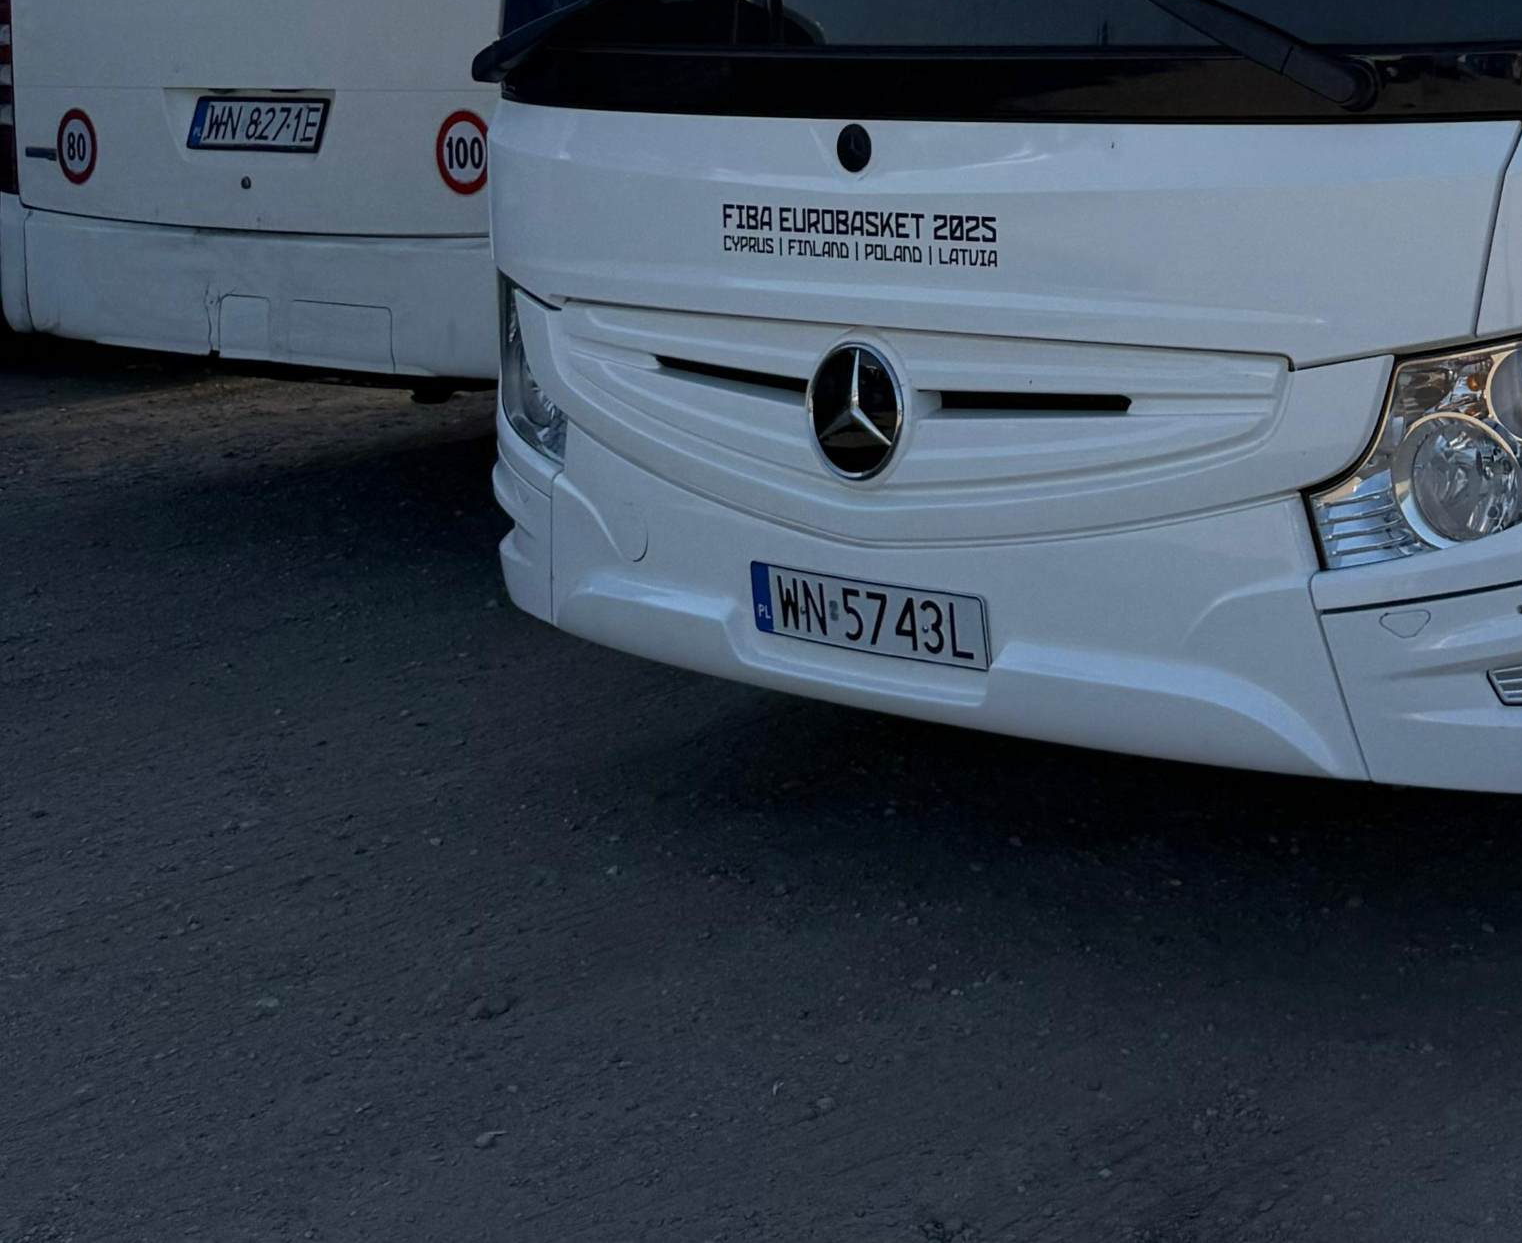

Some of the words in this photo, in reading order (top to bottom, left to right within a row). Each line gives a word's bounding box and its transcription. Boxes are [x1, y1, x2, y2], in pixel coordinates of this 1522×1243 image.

[203, 104, 243, 141] WN
[245, 106, 321, 143] 8271E
[66, 131, 87, 162] 80
[446, 136, 484, 170] 100
[722, 203, 773, 232] FIBA
[779, 207, 925, 240] EUROBASKET
[933, 214, 998, 243] 2025
[723, 235, 774, 255] CYPRUS
[788, 238, 849, 259] FINLAND
[864, 243, 923, 264] POLAND
[938, 247, 998, 268] LATVIA
[758, 603, 772, 620] PL
[776, 575, 828, 636] WN
[841, 587, 975, 660] 5743L
